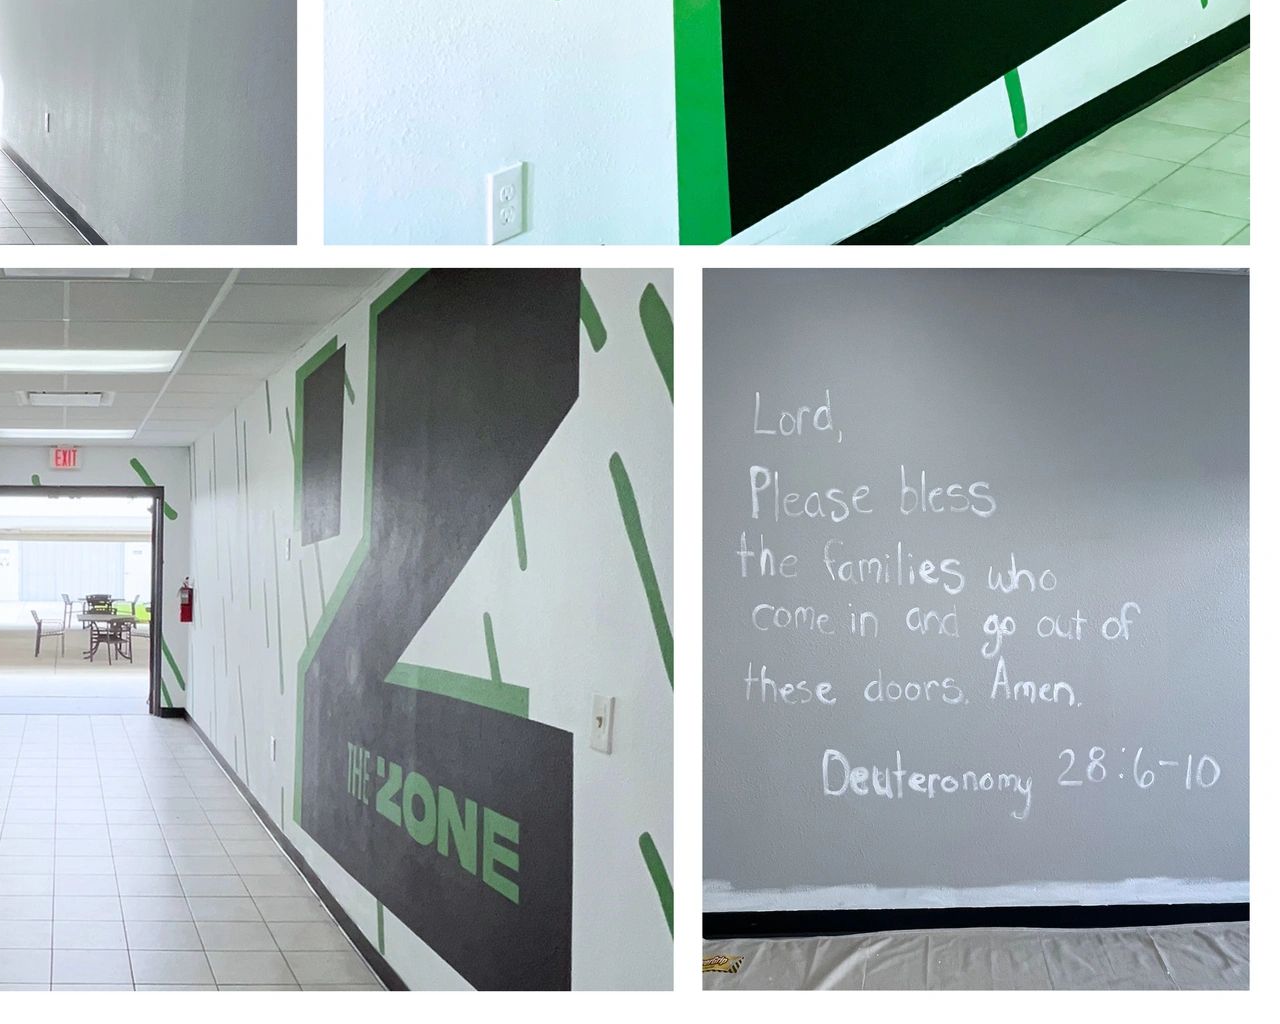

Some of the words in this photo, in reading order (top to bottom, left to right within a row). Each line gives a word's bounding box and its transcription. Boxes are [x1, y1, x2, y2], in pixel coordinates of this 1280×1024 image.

[753, 389, 843, 443] Lord,
[55, 449, 77, 466] EXIT
[749, 465, 874, 522] Please
[900, 465, 997, 517] bless
[736, 531, 798, 577] the
[823, 539, 965, 594] families
[988, 553, 1057, 593] who
[751, 603, 835, 634] come
[848, 603, 878, 636] in
[905, 605, 960, 637] and
[981, 612, 1016, 659] go
[1036, 609, 1087, 640] out
[1101, 601, 1141, 640] of
[744, 662, 837, 706] these
[863, 669, 969, 705] doors.
[991, 656, 1082, 707] Amen.
[822, 749, 1033, 819] Deuteronomy
[347, 741, 371, 806] THE
[376, 755, 520, 905] ZONE
